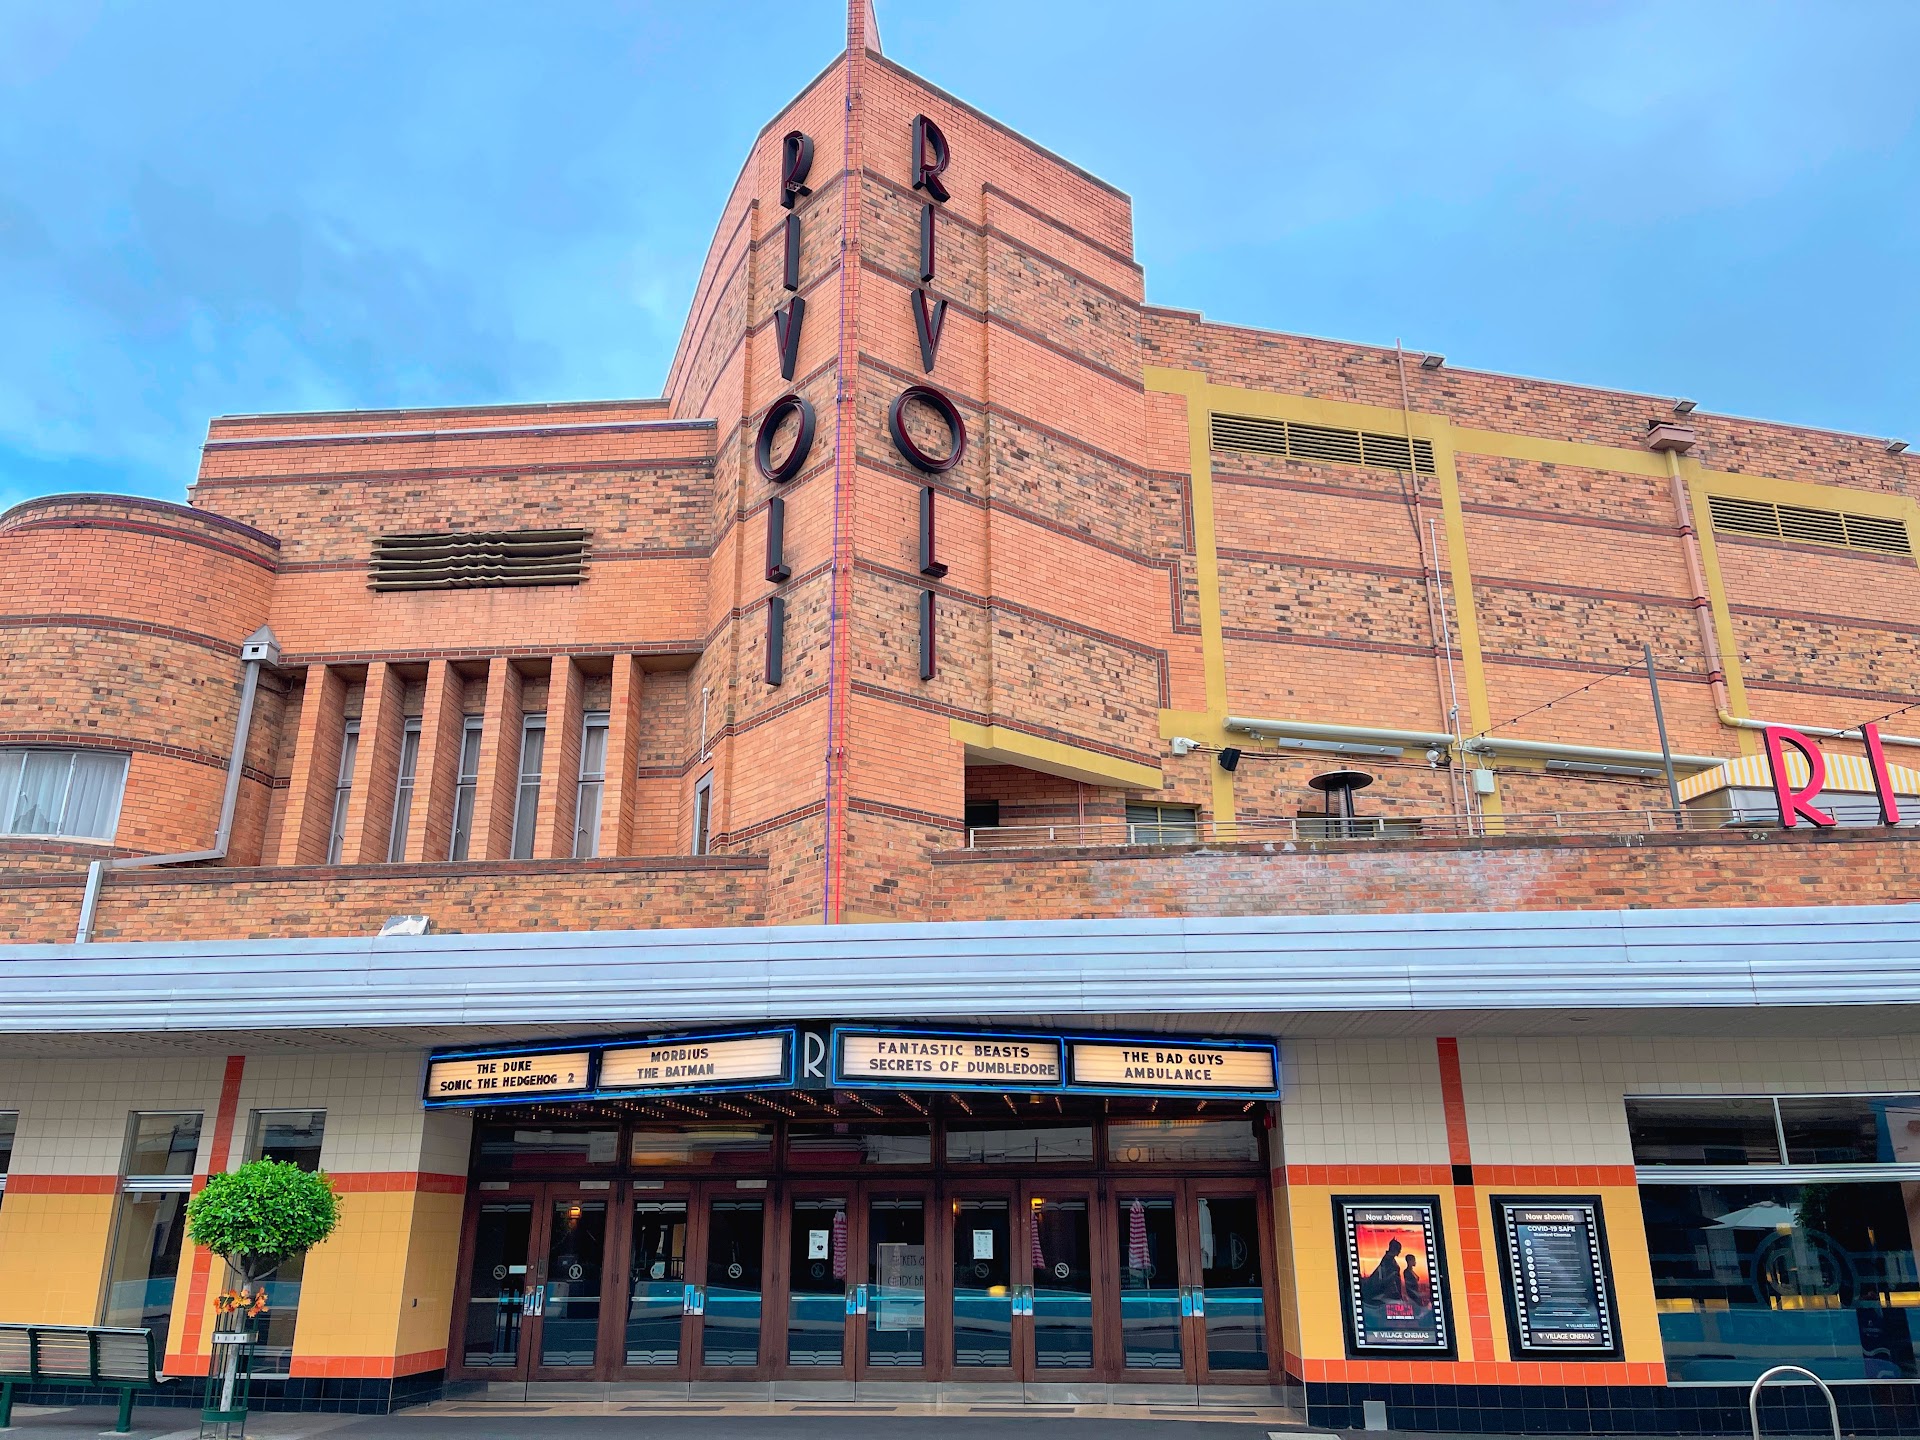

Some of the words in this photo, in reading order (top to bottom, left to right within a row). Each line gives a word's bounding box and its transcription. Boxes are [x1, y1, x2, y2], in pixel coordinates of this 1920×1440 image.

[889, 113, 967, 682] RIVOLI
[754, 130, 815, 687] RIVOLI
[1763, 723, 1900, 828] RI
[650, 1048, 709, 1063] MORBIUS
[803, 1032, 825, 1078] R
[878, 1042, 963, 1056] FANTASTIC
[974, 1045, 1030, 1058] BEASTS
[1122, 1051, 1149, 1062] THE
[1156, 1052, 1183, 1064] BAD
[1188, 1054, 1224, 1066] GUYS
[477, 1063, 497, 1075] THE
[503, 1061, 532, 1073] DUKE
[637, 1067, 659, 1080] THE
[665, 1063, 715, 1078] BATMAN
[869, 1058, 932, 1072] SECRETS
[939, 1061, 959, 1072] OF
[967, 1061, 1056, 1076] DUMBLEDORE
[1124, 1067, 1212, 1081] AMBULANCE
[440, 1080, 472, 1092] SONIC
[478, 1077, 498, 1089] THE
[502, 1073, 558, 1088] HEDGEHOG
[567, 1073, 575, 1084] 2
[1365, 1213, 1382, 1221] Now
[1383, 1213, 1414, 1222] showing
[1543, 1213, 1575, 1222] showing
[891, 1255, 917, 1267] TKETS
[887, 1275, 912, 1287] CDY
